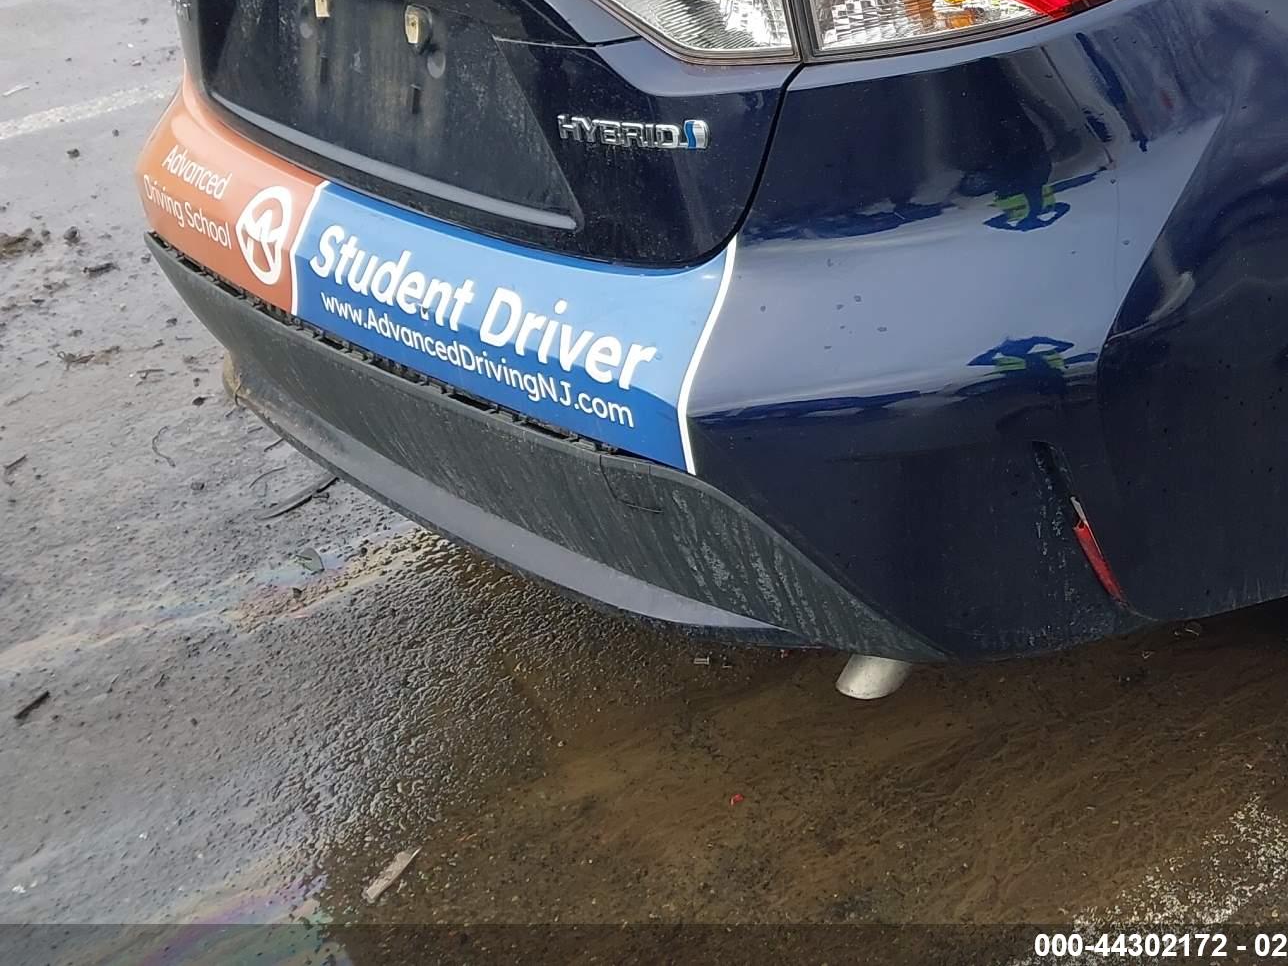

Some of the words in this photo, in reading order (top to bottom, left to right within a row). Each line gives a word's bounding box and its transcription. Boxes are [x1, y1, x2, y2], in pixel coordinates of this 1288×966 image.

[557, 114, 681, 149] HYBRID
[161, 145, 233, 200] Advanced
[143, 174, 186, 228] Driving
[183, 201, 232, 250] School
[309, 225, 476, 332] Student
[480, 287, 656, 389] Driver
[321, 291, 635, 428] www.AdvancedDrivingNJ.com
